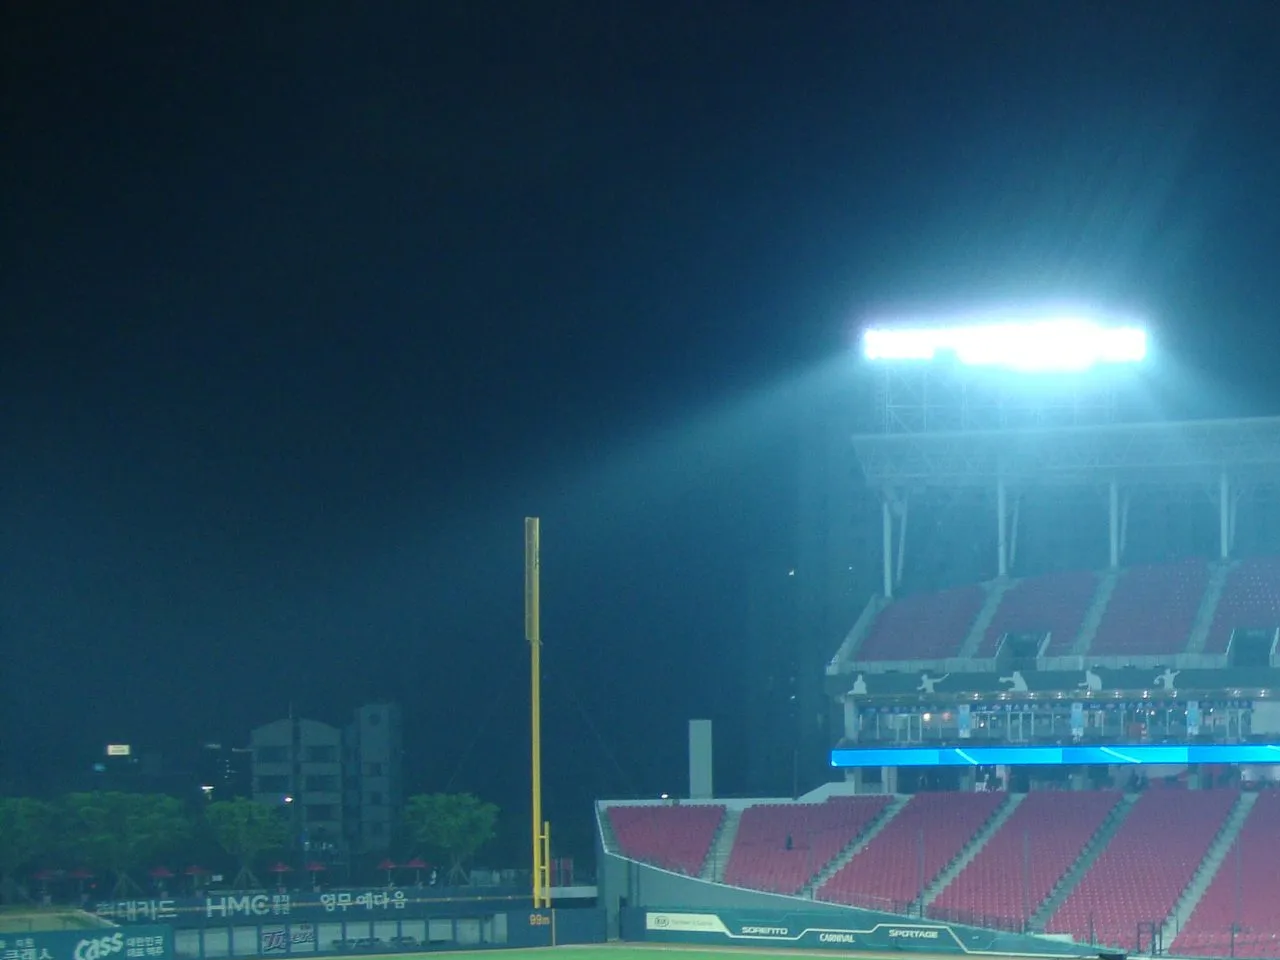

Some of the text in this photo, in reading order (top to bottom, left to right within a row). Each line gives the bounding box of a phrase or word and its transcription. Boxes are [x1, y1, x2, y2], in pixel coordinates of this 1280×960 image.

[206, 895, 269, 917] HMC
[819, 933, 855, 943] CARNIVAL
[888, 929, 939, 939] SPORTAGE
